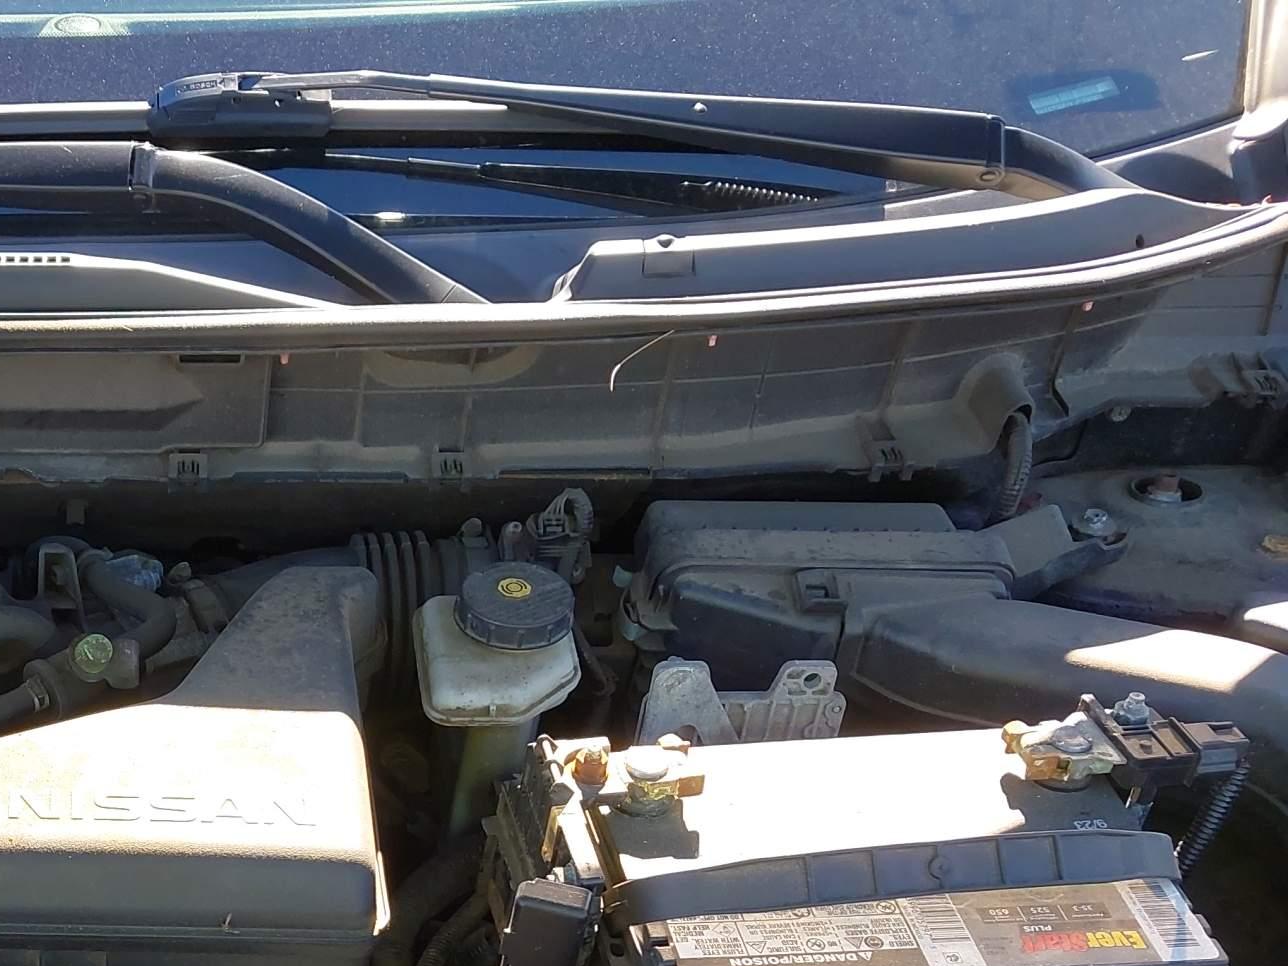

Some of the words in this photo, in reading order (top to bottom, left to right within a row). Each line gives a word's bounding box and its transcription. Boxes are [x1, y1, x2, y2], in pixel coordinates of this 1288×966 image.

[8, 791, 317, 827] NISSAN
[1022, 924, 1053, 933] PLUS
[1021, 930, 1147, 953] EverStart
[729, 952, 858, 966] DANGER/POISON
